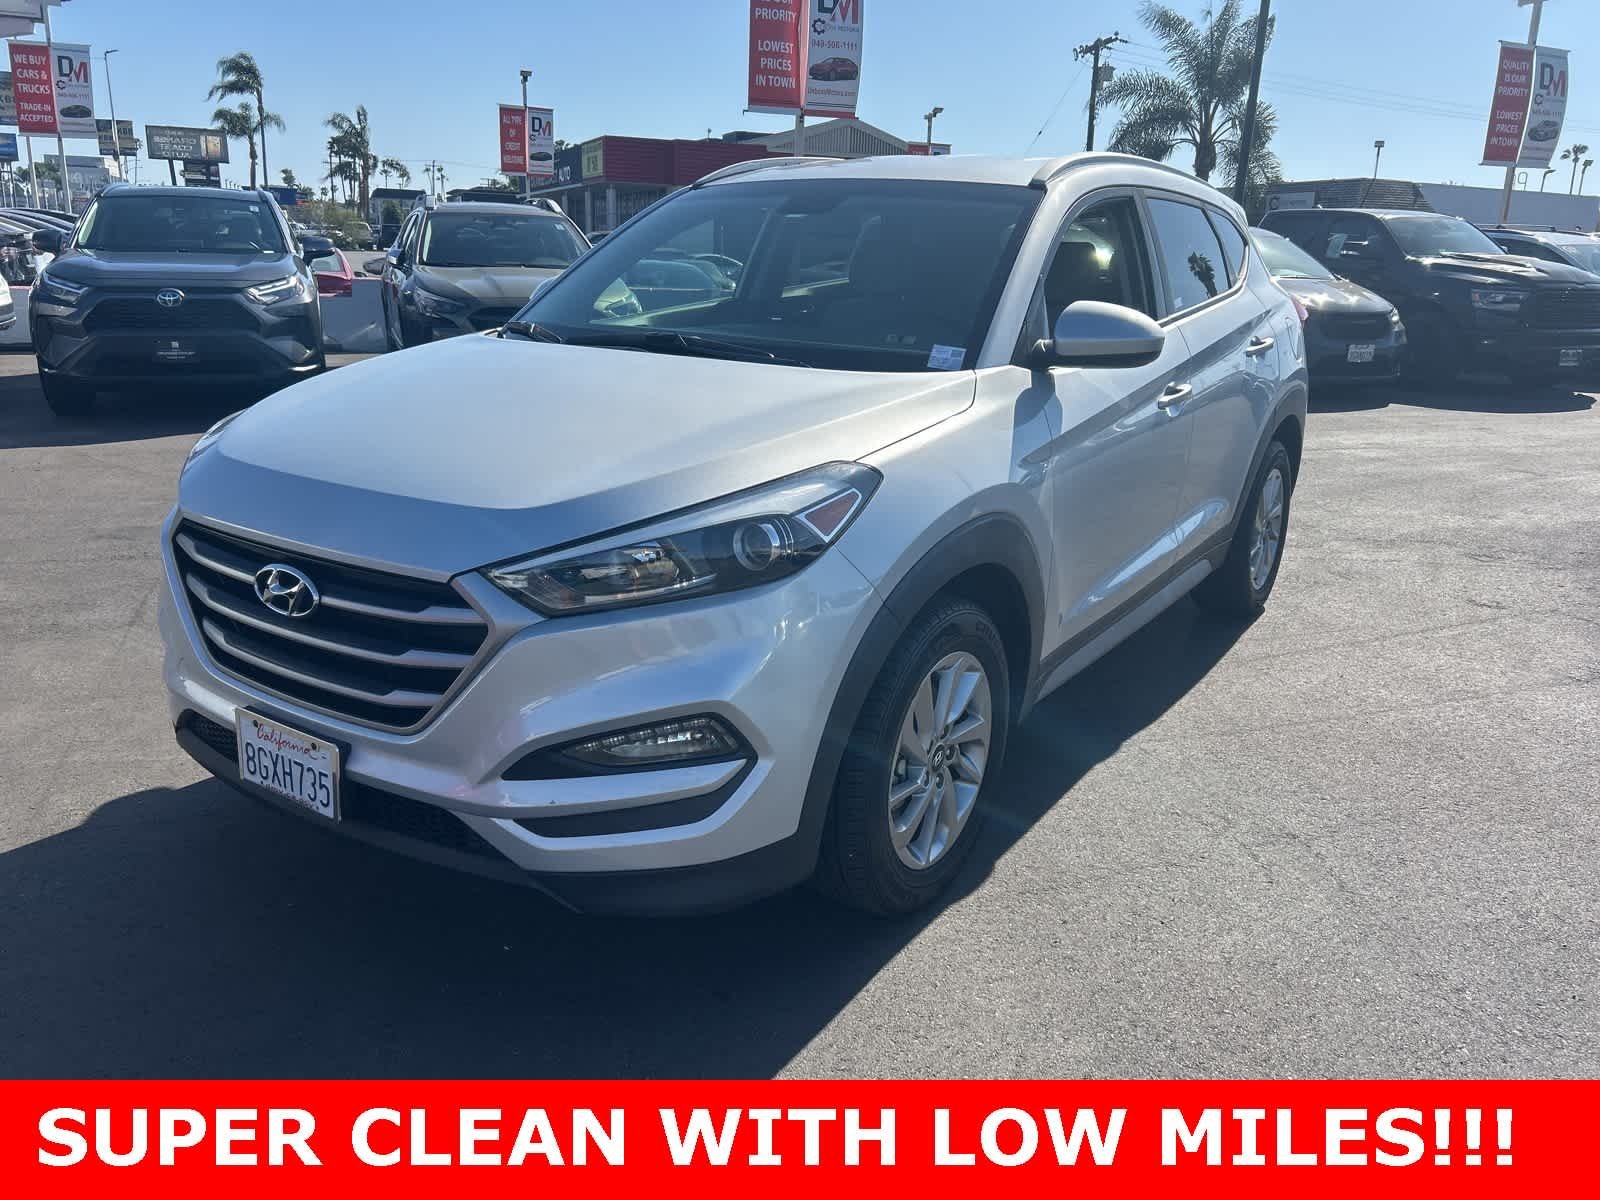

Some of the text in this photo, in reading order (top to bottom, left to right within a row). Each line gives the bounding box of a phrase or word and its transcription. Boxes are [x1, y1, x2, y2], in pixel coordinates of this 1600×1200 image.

[755, 7, 796, 22] PRIORITY
[758, 40, 794, 54] LOWEST
[13, 54, 47, 65] WE BUY
[760, 57, 792, 71] PRICES
[1502, 60, 1530, 71] QUALITY
[16, 69, 48, 80] CARS &
[755, 75, 796, 88] IN TOWN
[17, 83, 50, 94] TRUCKS
[1498, 86, 1529, 97] PRIORITY
[20, 102, 51, 112] TRADE-IN
[20, 114, 54, 123] ACCEPTED
[1496, 110, 1523, 120] LOWEST
[1495, 123, 1519, 134] PRICES
[257, 724, 310, 754] California
[246, 742, 330, 807] 8GXH735
